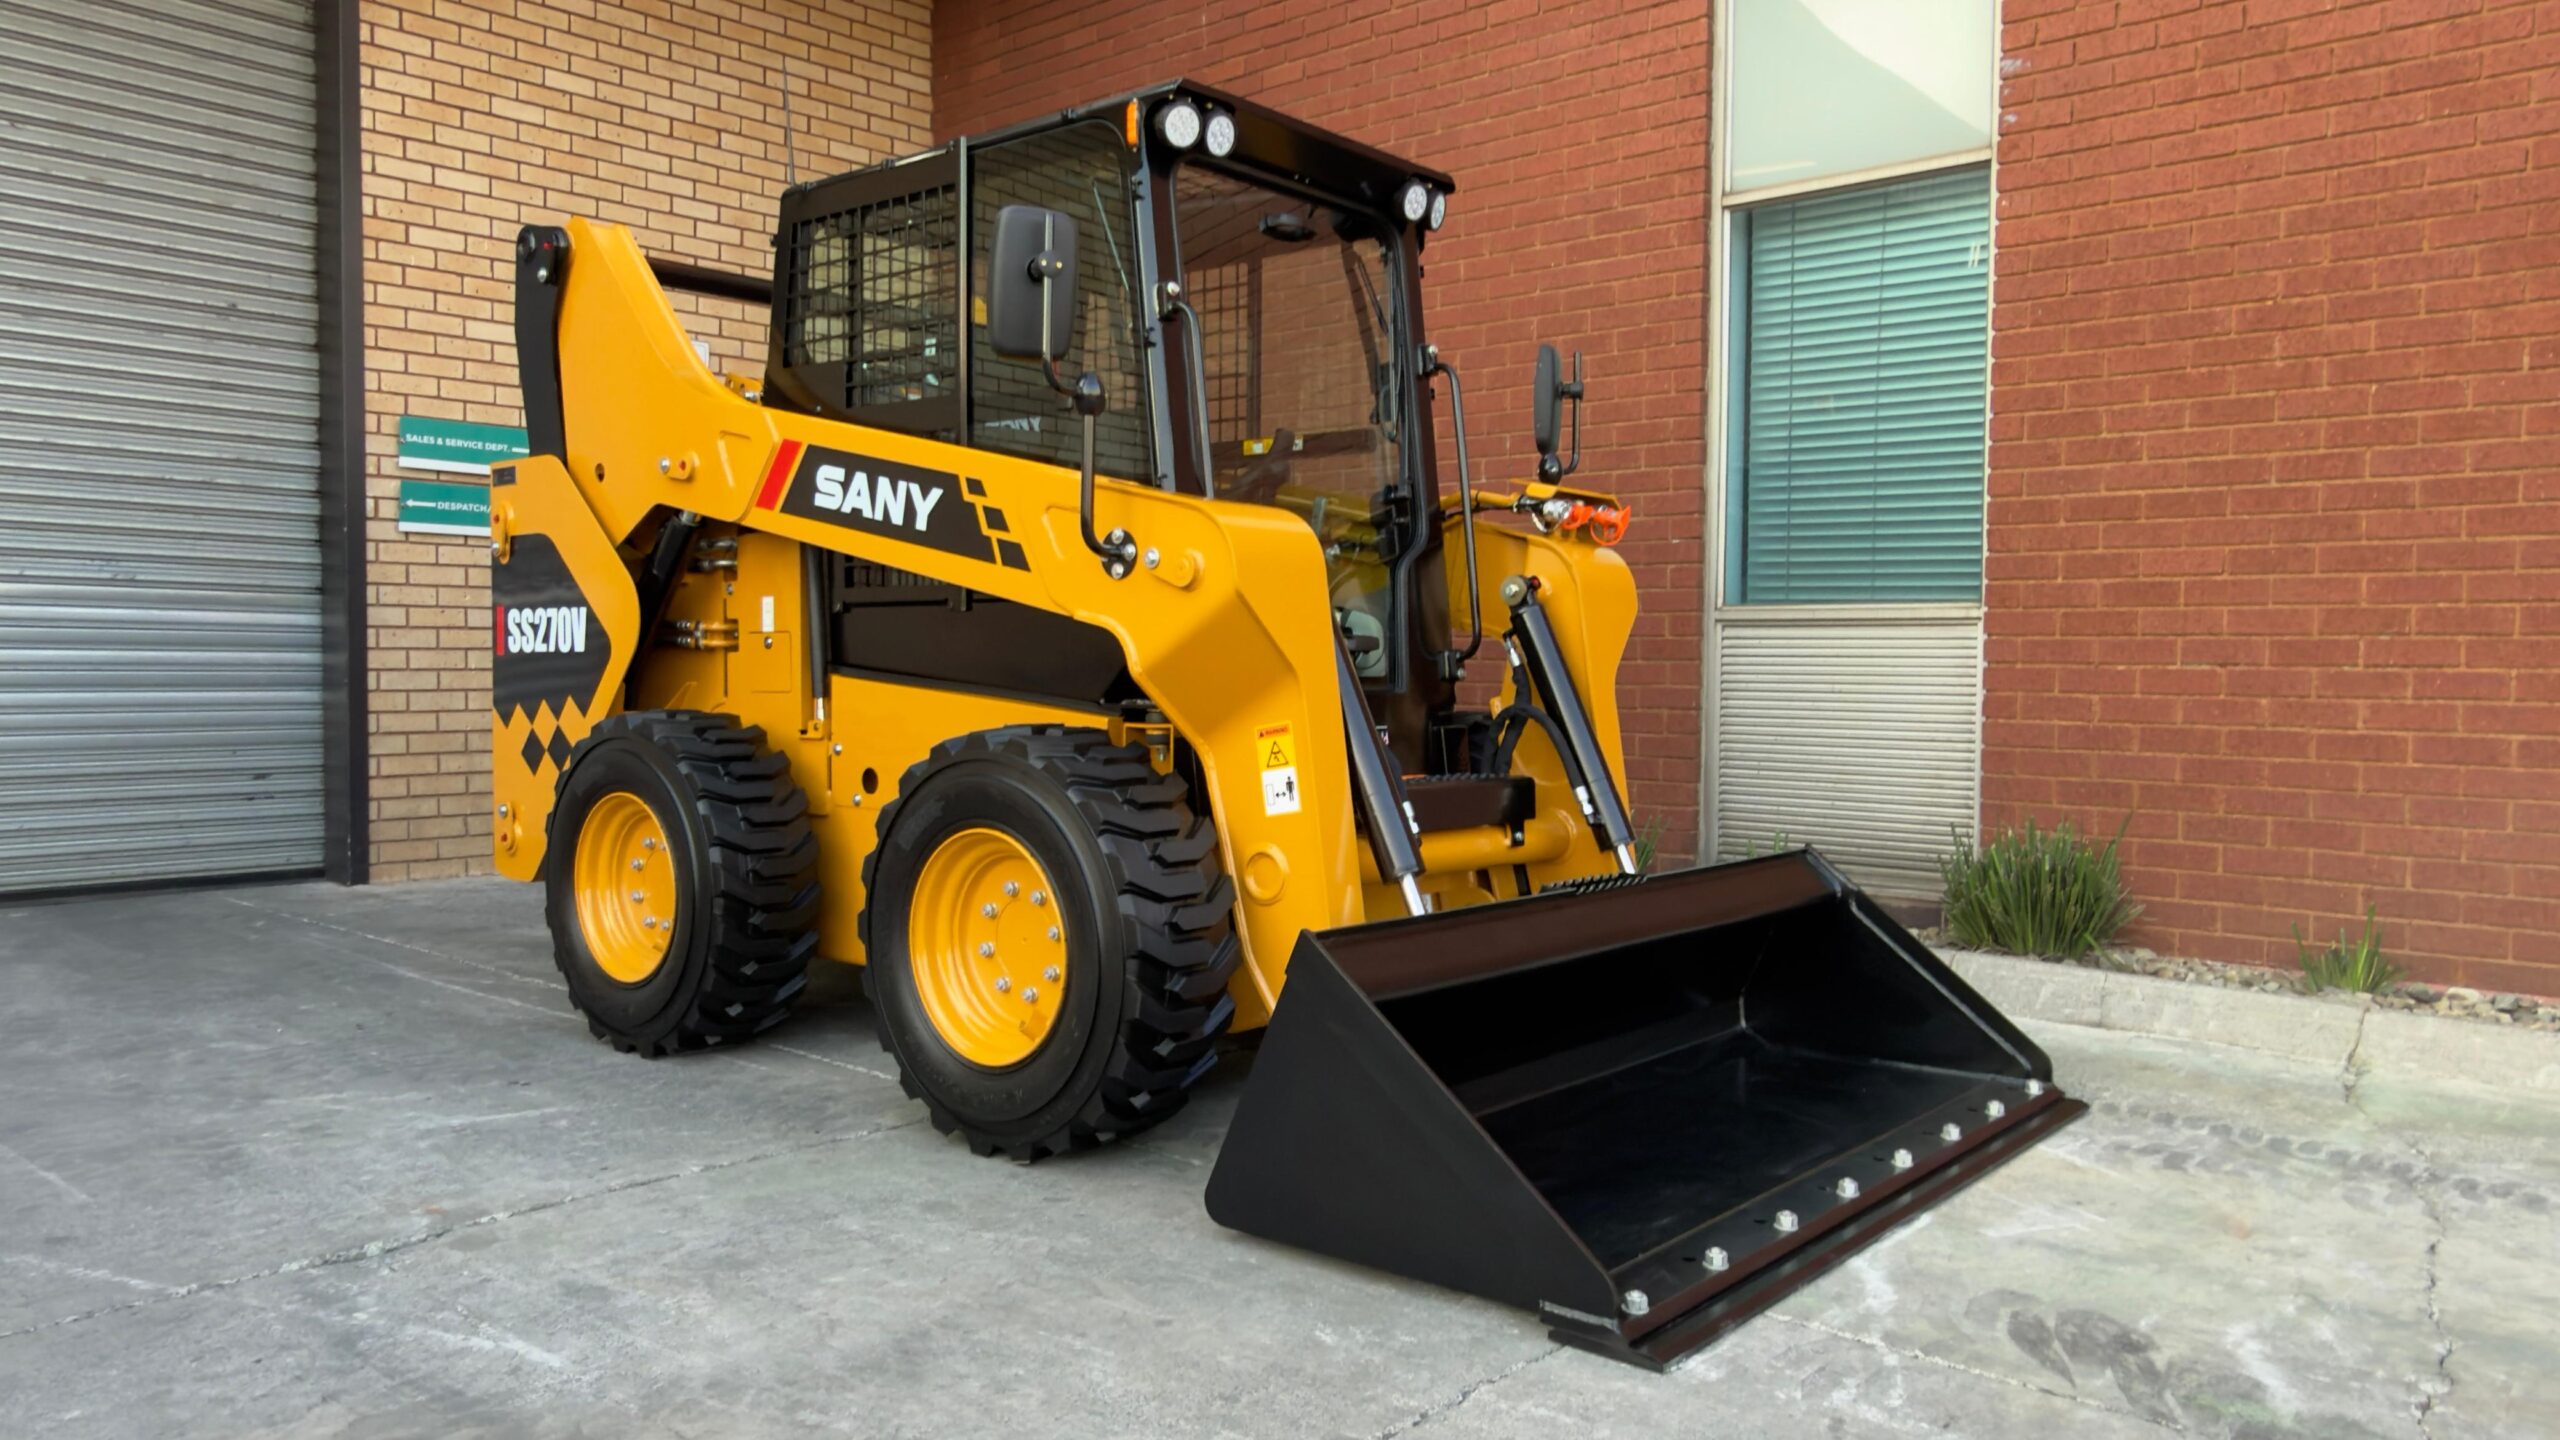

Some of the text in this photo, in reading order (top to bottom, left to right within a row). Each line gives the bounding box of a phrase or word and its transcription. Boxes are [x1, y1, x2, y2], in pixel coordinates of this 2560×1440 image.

[405, 433, 511, 453] SALES & SERVICE DEPT.
[814, 464, 944, 532] SANY
[507, 606, 588, 654] SS270V
